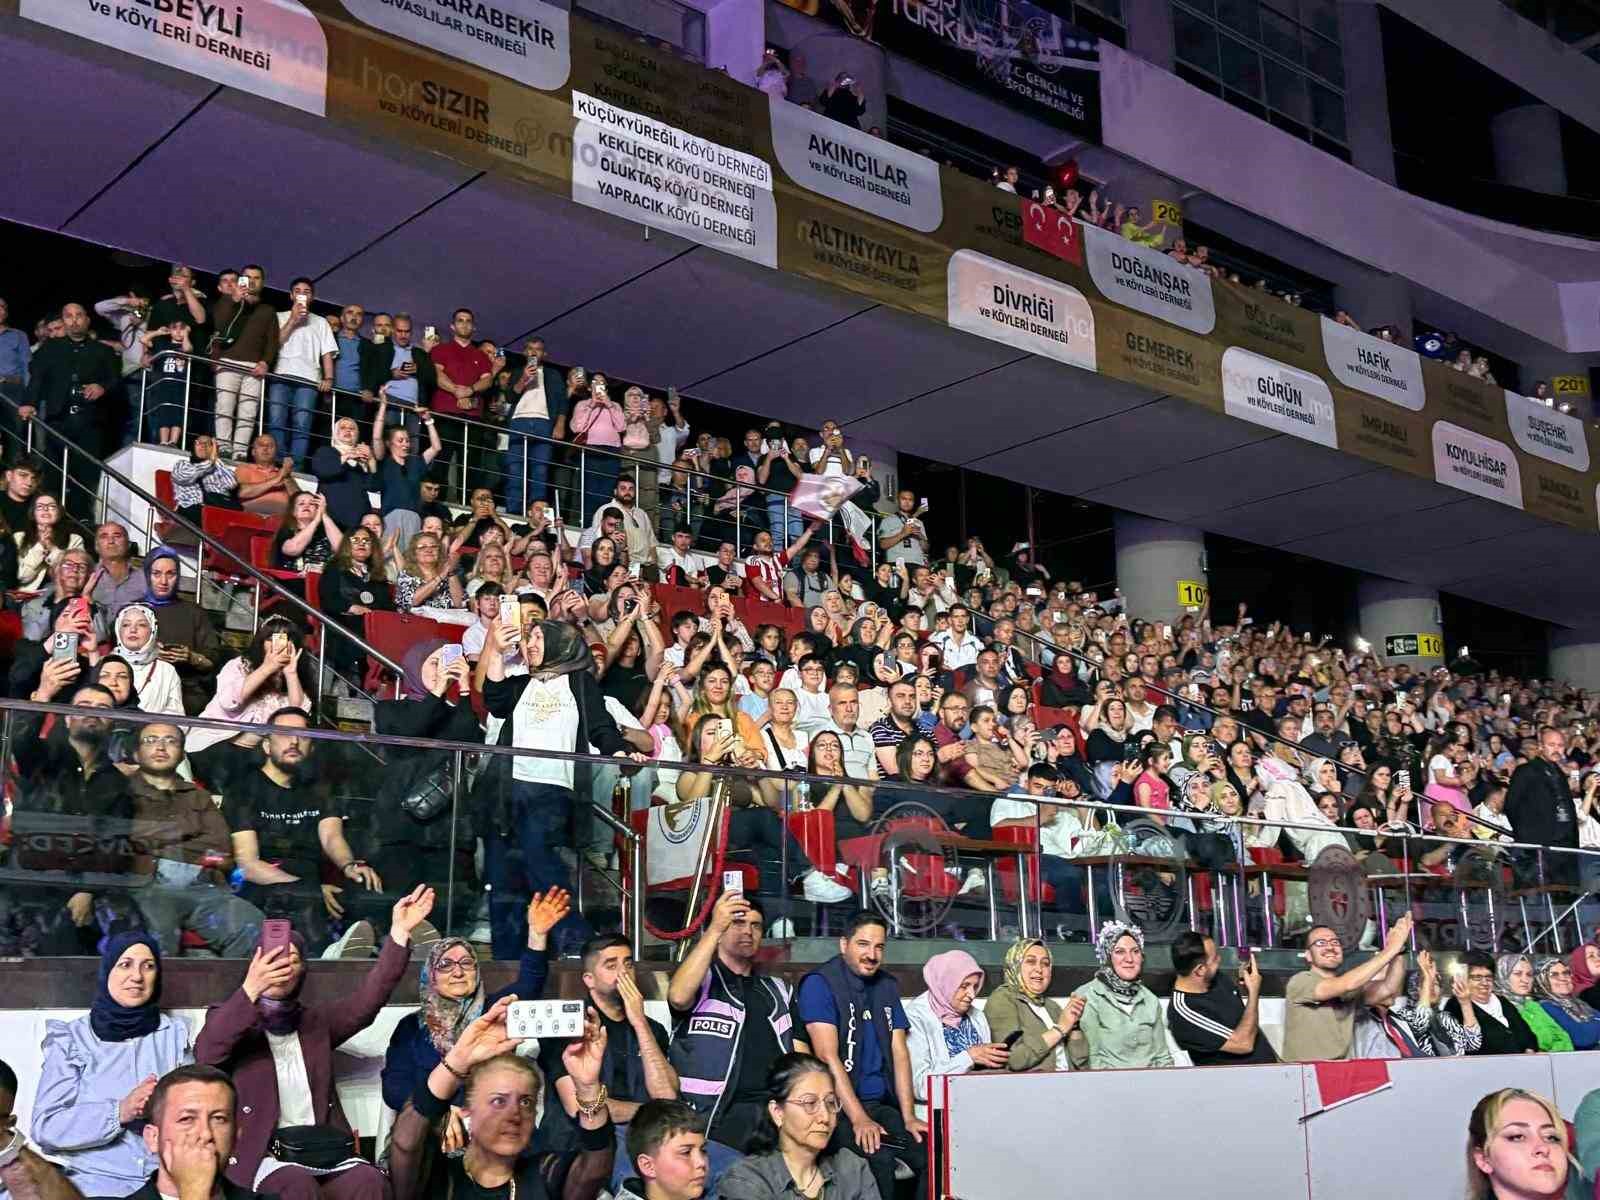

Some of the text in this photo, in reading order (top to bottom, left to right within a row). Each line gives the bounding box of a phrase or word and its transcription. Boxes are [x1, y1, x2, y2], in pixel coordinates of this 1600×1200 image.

[89, 0, 111, 16] ve
[115, 6, 191, 44] KÖYLERİ
[195, 33, 270, 71] DERNEĞİ
[134, 0, 243, 38] BEYLİ
[381, 0, 527, 57] VASLILAR DERNEĞİ
[436, 0, 556, 50] ARABEKİR
[401, 103, 462, 137] KÖYLERİ
[422, 80, 490, 124] SIZIR
[577, 99, 680, 149] KÜÇÜKYÜREĞİL
[682, 139, 715, 163] KÖYÜ
[717, 152, 769, 182] DERNEĞİ
[808, 135, 909, 189] AKINCILAR
[599, 132, 756, 200] KEKLİCEK KÖYÜ DERNEĞİ
[809, 160, 911, 206] ve KÖYLERİ DERNEĞİ
[600, 157, 754, 222] OLUKTAŞ KÖYÜ DERNEĞİ
[597, 181, 756, 246] YAPRACIK KÖYÜ DERNEĞİ
[809, 219, 919, 276] ALTINYAYLA
[1111, 252, 1191, 297] DOĞANŞAR
[979, 306, 1069, 345] ve KÖYLERİ DERNEĞİ
[993, 284, 1054, 323] DİVRİĞİ
[1126, 332, 1194, 371] GEMEREK
[1357, 346, 1392, 373] HAFİK
[1257, 375, 1302, 407] GÜRÜN
[1446, 442, 1507, 477] KOYULHİSAR
